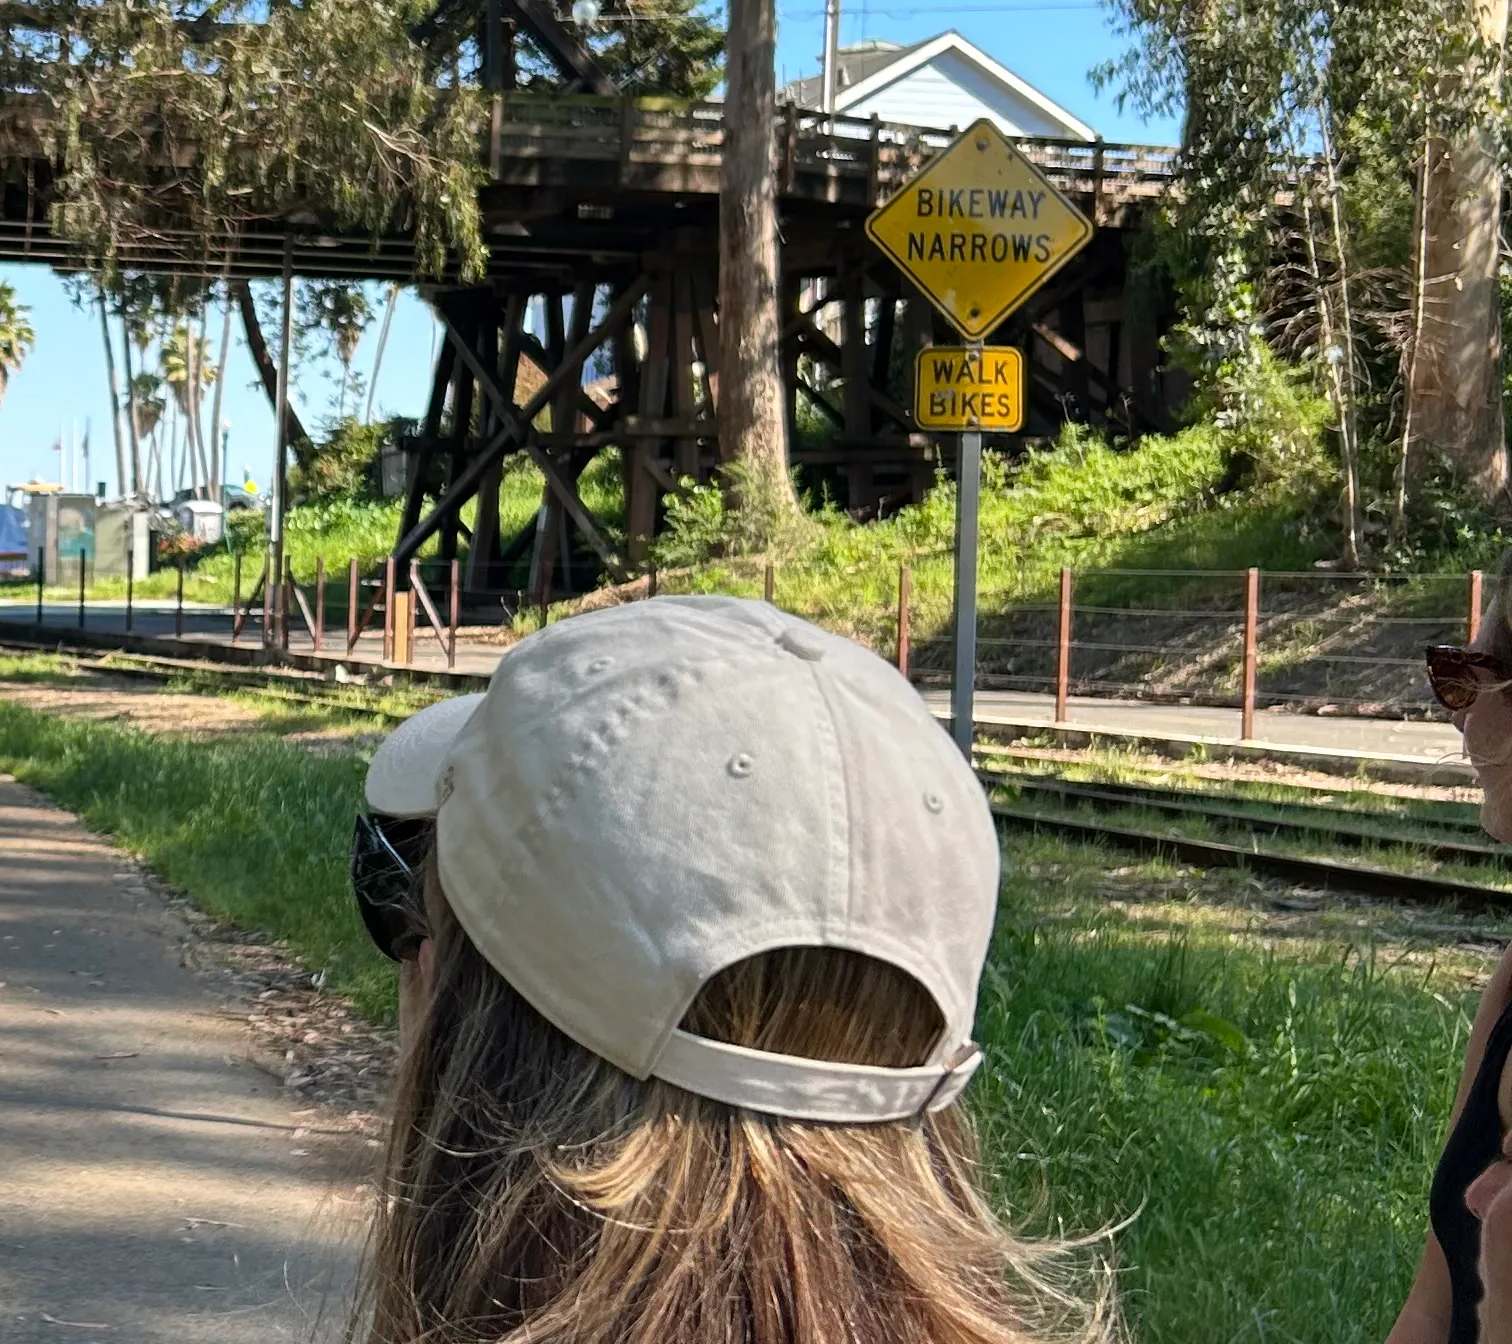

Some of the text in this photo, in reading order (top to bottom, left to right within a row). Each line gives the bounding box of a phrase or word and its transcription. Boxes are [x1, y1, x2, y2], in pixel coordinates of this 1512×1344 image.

[917, 188, 1046, 220] BIKEWAY
[907, 231, 1051, 263] NARROWS
[932, 358, 1008, 385] WALK
[929, 391, 1010, 419] BIKES
